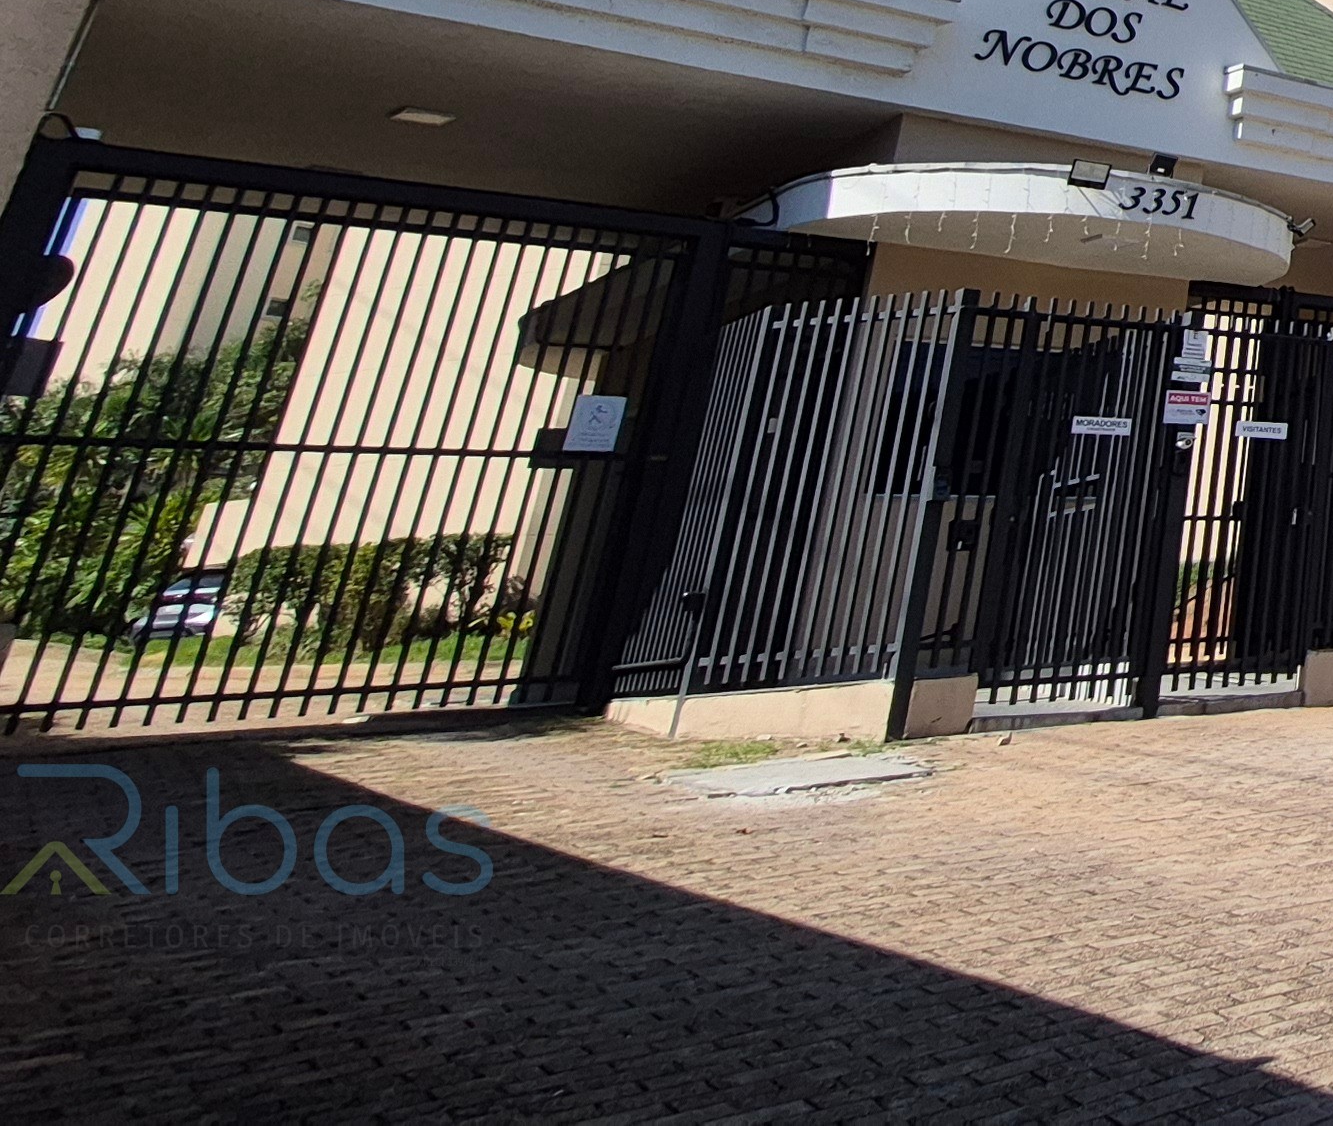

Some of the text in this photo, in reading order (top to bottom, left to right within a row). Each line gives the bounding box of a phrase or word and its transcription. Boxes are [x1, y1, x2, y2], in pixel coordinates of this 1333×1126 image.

[974, 29, 1185, 100] NOBRES
[1118, 187, 1199, 220] 3351
[1170, 395, 1208, 403] AQUI TEM
[1075, 419, 1128, 429] MORADORES
[1242, 425, 1282, 435] VISITANTES
